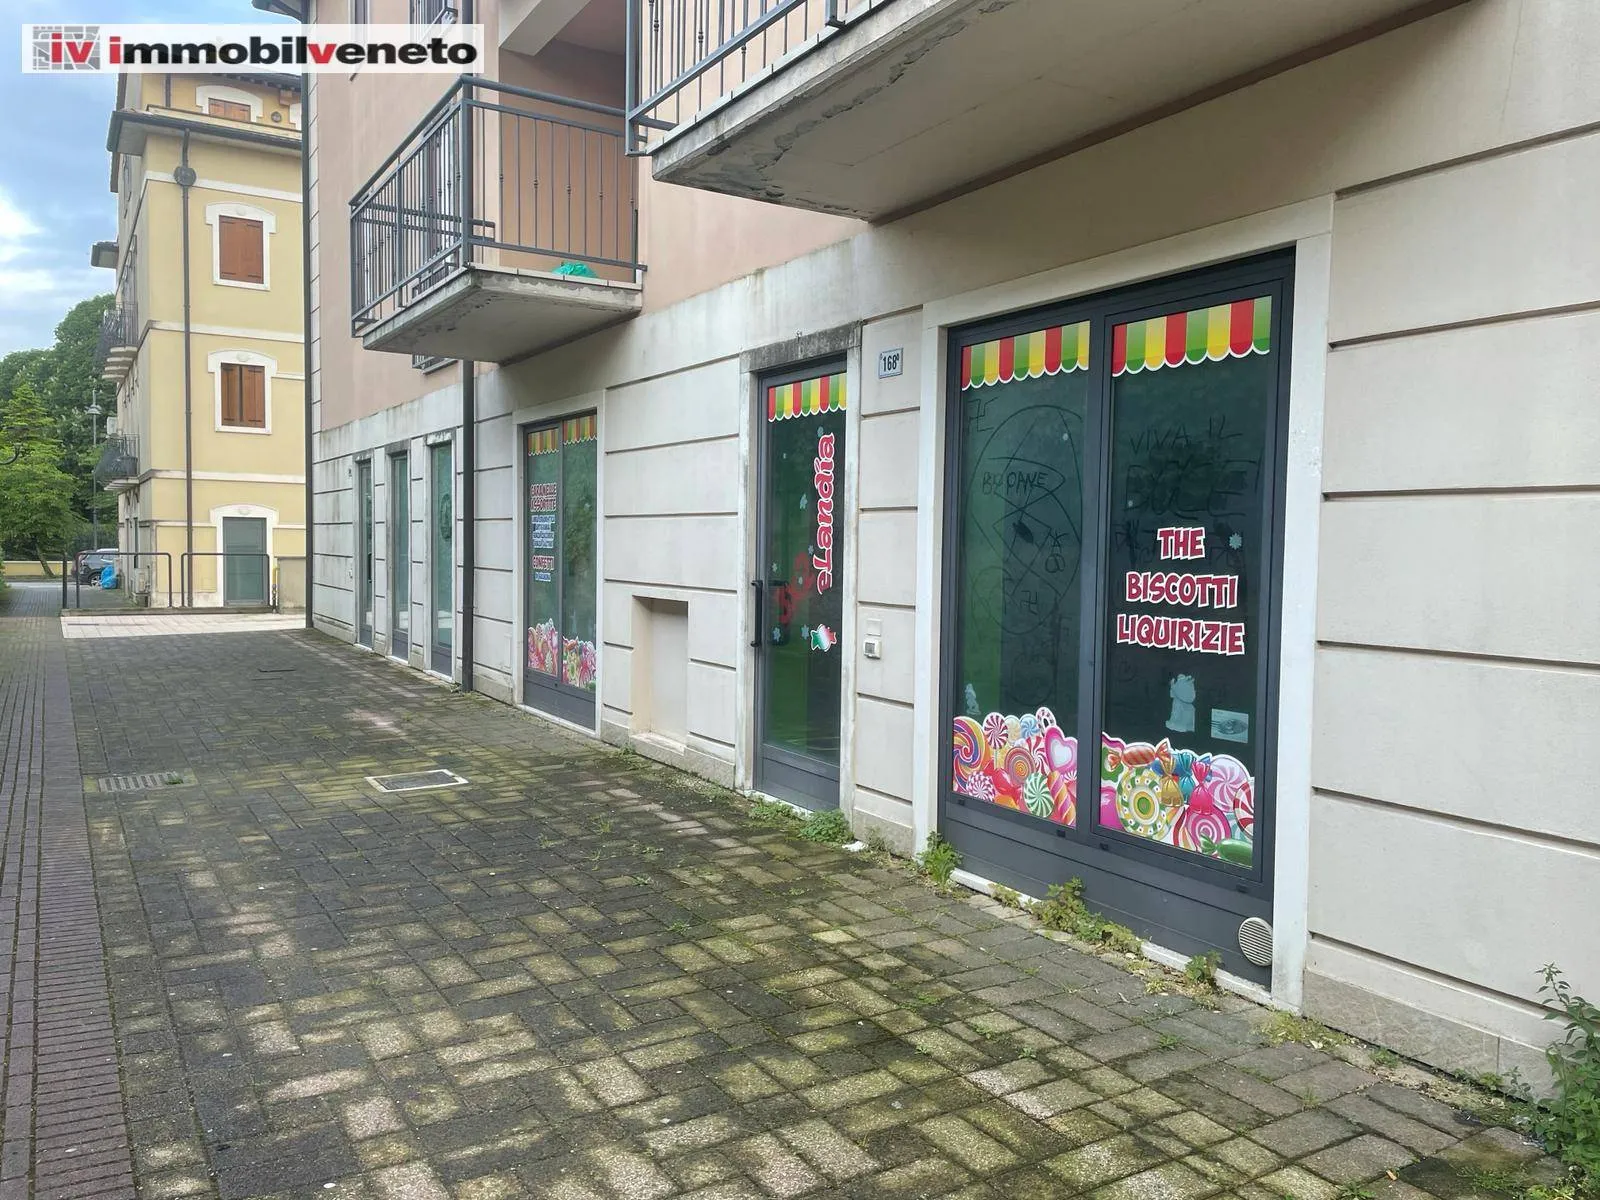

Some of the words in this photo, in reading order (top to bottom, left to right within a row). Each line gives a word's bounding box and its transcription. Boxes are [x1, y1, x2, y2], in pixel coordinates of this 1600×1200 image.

[1157, 526, 1206, 560] THE
[1126, 572, 1238, 609] BISCOTTI
[1117, 614, 1245, 655] LIQUIRIZIE
